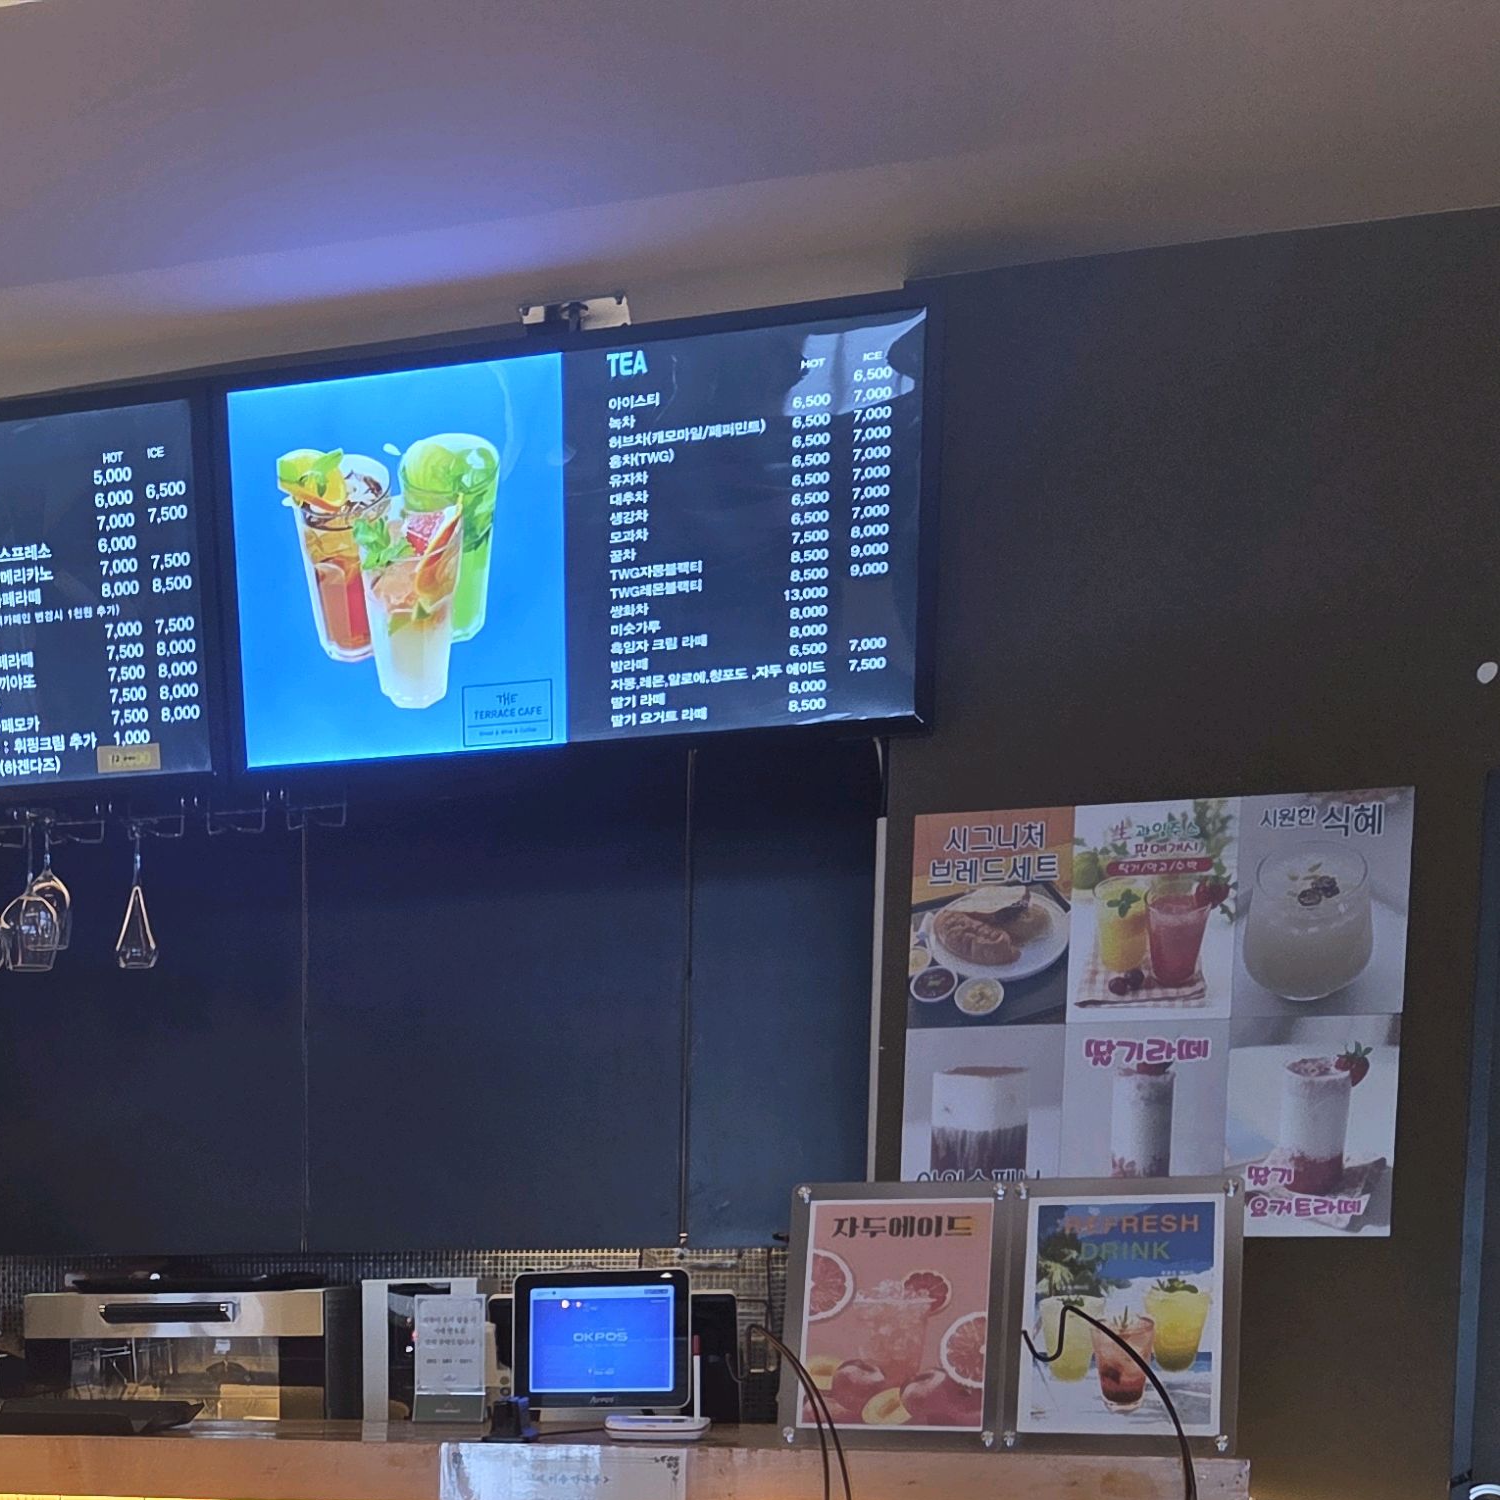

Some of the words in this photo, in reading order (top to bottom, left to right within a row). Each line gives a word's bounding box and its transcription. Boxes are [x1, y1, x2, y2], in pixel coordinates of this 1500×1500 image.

[607, 350, 648, 378] TEA
[801, 357, 826, 370] HOT
[862, 351, 883, 362] ICE
[608, 392, 660, 411] 아이스티
[853, 366, 893, 382] 6,500
[792, 393, 831, 409] 6,500
[853, 386, 892, 402] 7,000
[792, 413, 831, 429] 6,500
[853, 406, 892, 422] 7,000
[792, 432, 831, 449] 6,500
[853, 425, 892, 442] 7,000
[102, 451, 124, 464] HOT
[147, 446, 165, 459] ICE
[93, 467, 132, 486] 5,000
[609, 471, 649, 488] 유자차
[94, 490, 133, 508] 6,000
[145, 481, 186, 500] 6,500
[609, 490, 649, 507] 대추차
[97, 513, 135, 532] 7,000
[147, 504, 188, 524] 7,500
[609, 509, 649, 525] 생강차
[609, 528, 649, 544] 모과차
[791, 529, 829, 544] 7,500
[850, 523, 889, 539] 8,000
[98, 535, 136, 554] 6,000
[790, 548, 829, 563] 8,500
[850, 542, 889, 558] 9,000
[100, 557, 138, 577] 7,000
[150, 552, 191, 571] 7,500
[101, 580, 139, 598] 8,000
[152, 575, 192, 593] 8,500
[783, 586, 828, 601] 13,000
[789, 605, 828, 620] 8,000
[104, 621, 142, 639] 7,000
[155, 616, 194, 635] 7,500
[849, 657, 887, 673] 7,500
[788, 680, 827, 694] 8,000
[111, 707, 149, 726] 7,500
[161, 704, 200, 722] 8,000
[474, 708, 515, 720] TERRACE
[518, 706, 542, 716] CAFE
[788, 698, 827, 713] 8,500
[69, 731, 97, 750] 추가
[113, 729, 150, 748] 1,000
[1259, 806, 1317, 829] 시원한
[1320, 801, 1385, 838] 식혜
[944, 819, 1046, 854] 시그니처
[927, 852, 1060, 886] 브레드세트
[1084, 1038, 1211, 1066] 딸기라떼
[1247, 1165, 1294, 1186] 딸기
[1248, 1197, 1363, 1218] 요거트라떼
[830, 1215, 974, 1239] 자두에이드
[1063, 1213, 1200, 1235] REFRESH
[1081, 1240, 1170, 1262] DRINK
[572, 1332, 628, 1342] OKPOS
